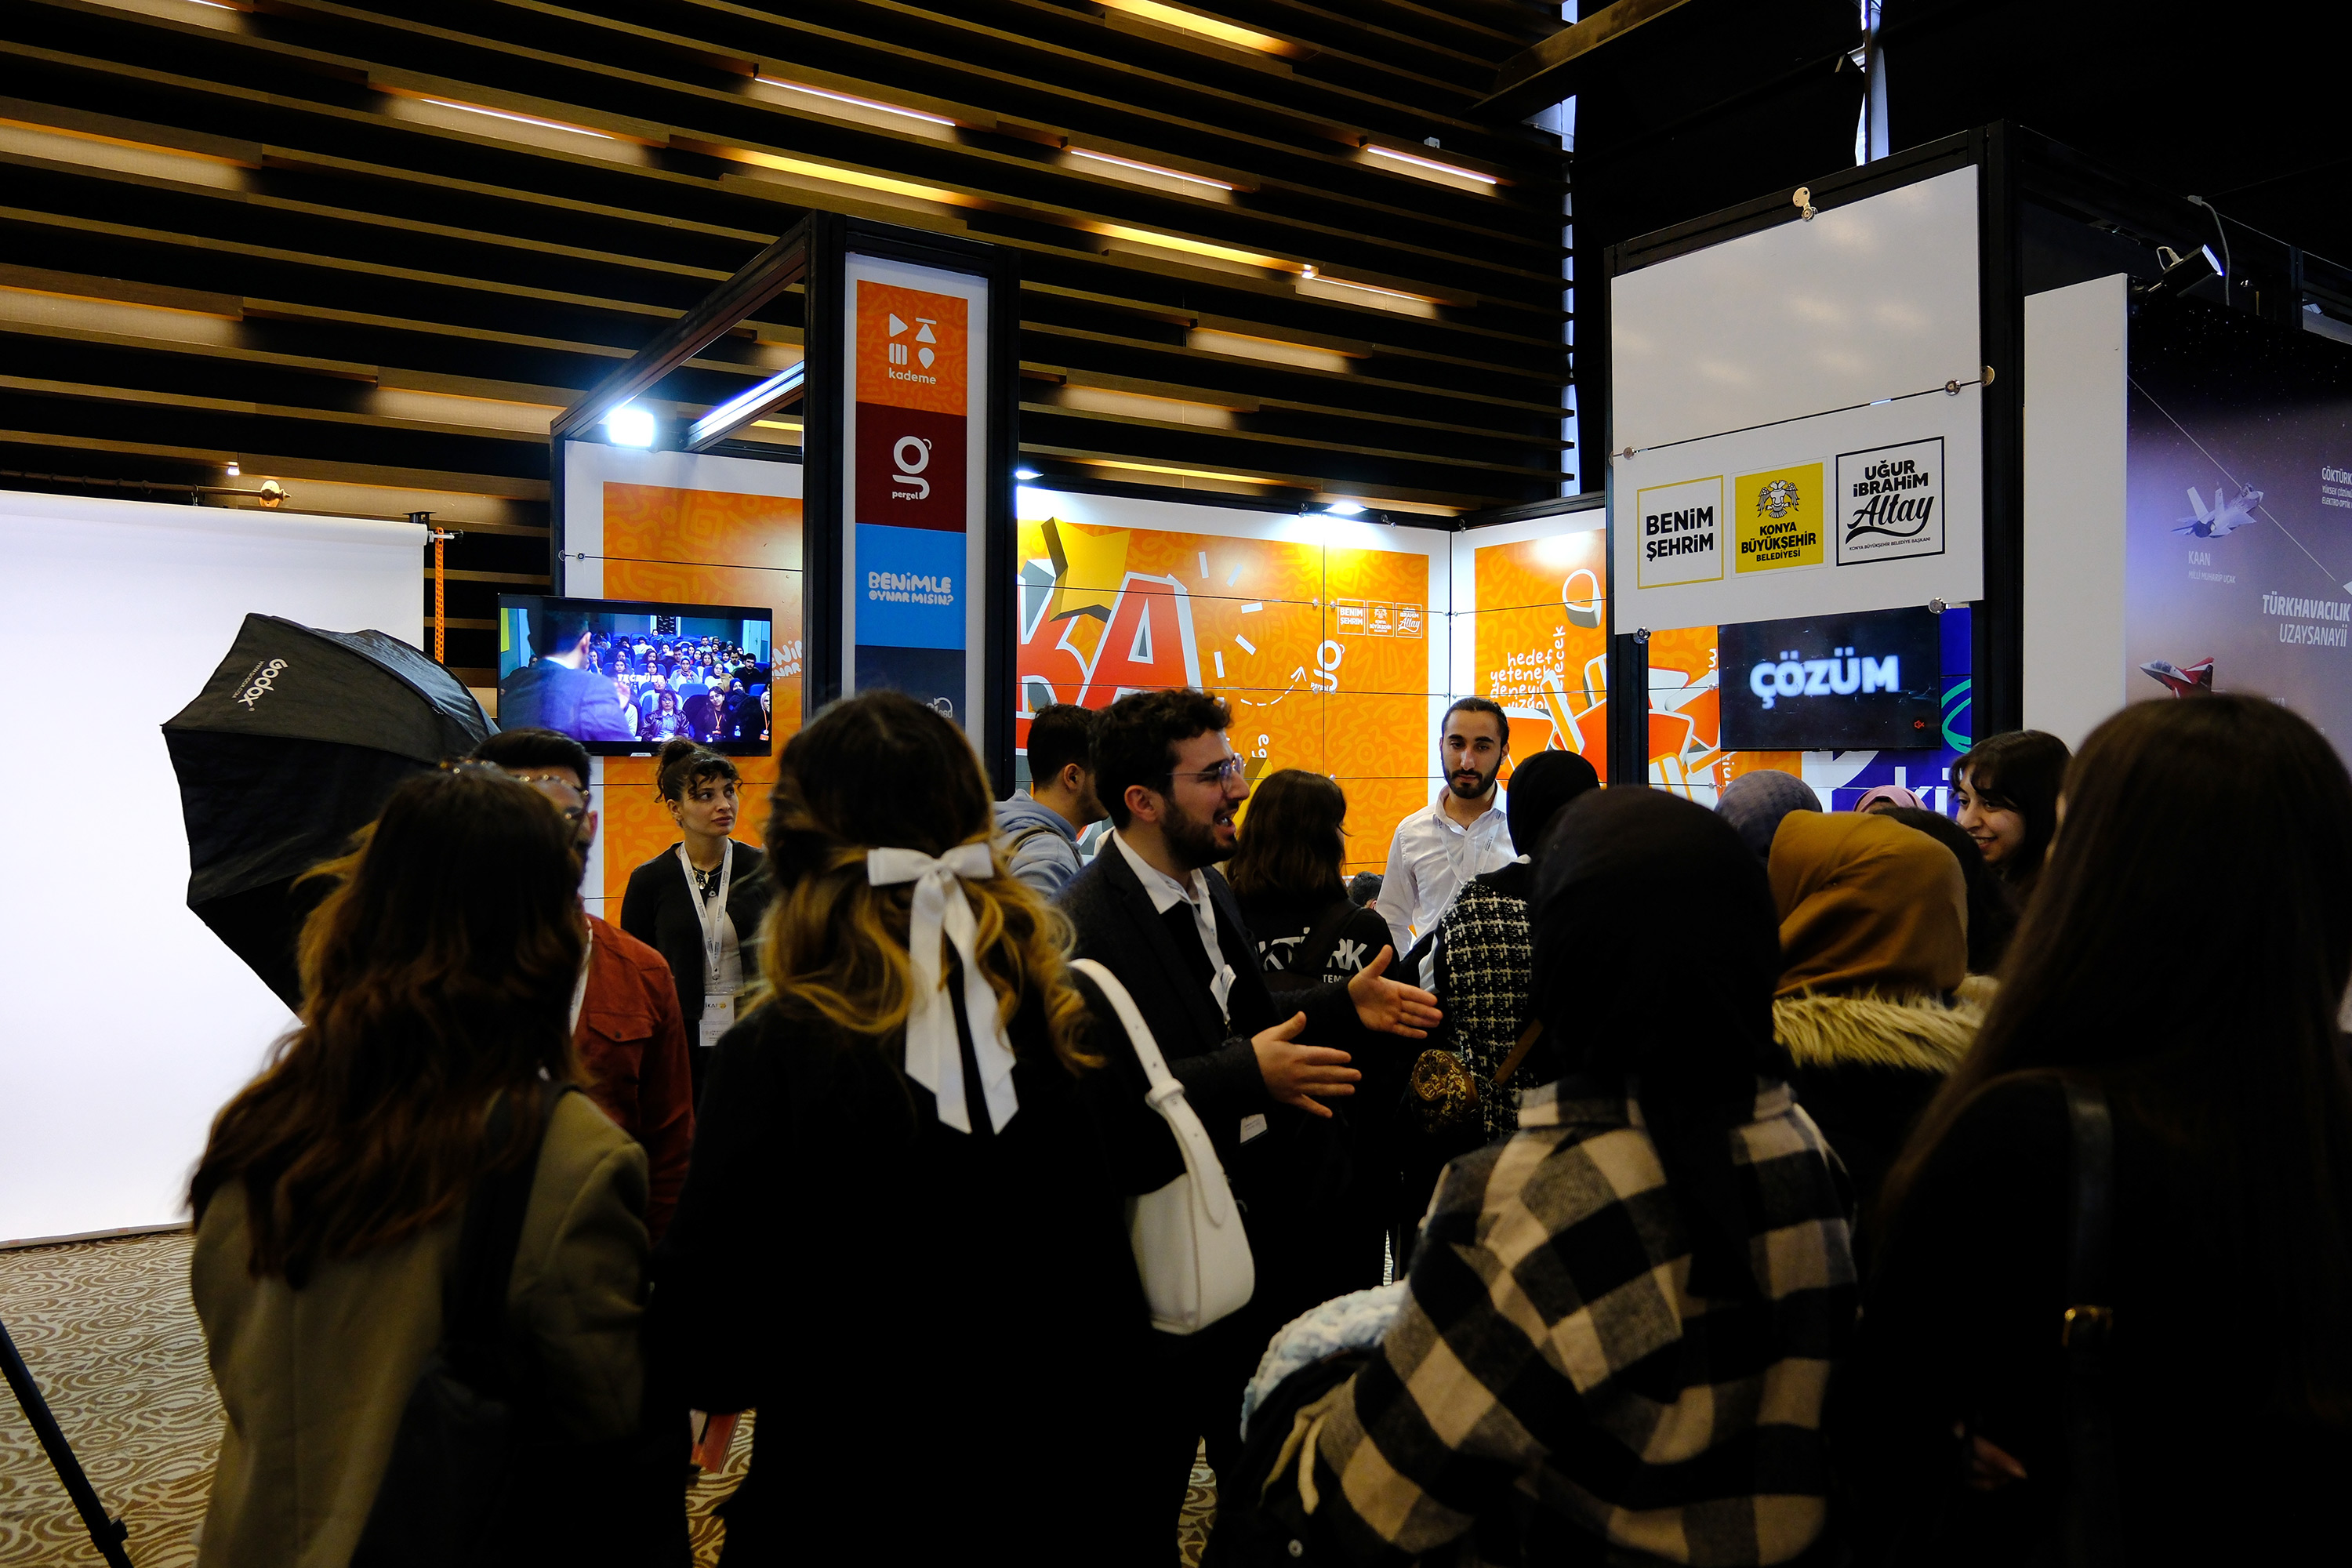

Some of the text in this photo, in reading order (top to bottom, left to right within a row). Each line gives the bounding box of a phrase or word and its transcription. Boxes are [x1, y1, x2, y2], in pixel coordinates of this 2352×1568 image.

[888, 367, 937, 385] kademe
[1864, 459, 1915, 481] UĞUR
[2321, 466, 2352, 485] GÖKTÜRK
[892, 491, 920, 501] pergel
[1845, 493, 1935, 545] Altay
[1759, 521, 1797, 536] KONYA
[1740, 530, 1817, 554] BÜYÜKŞEHİR
[1756, 550, 1801, 562] BELEDİYESİ
[2188, 550, 2211, 566] KAAN
[2201, 572, 2223, 583] MUHARİP
[2223, 575, 2236, 585] UÇAK
[869, 590, 910, 603] OYNAR
[1507, 648, 1553, 667] hedef
[238, 659, 289, 706] Godox
[1750, 647, 1900, 709] ÇÖZÜM
